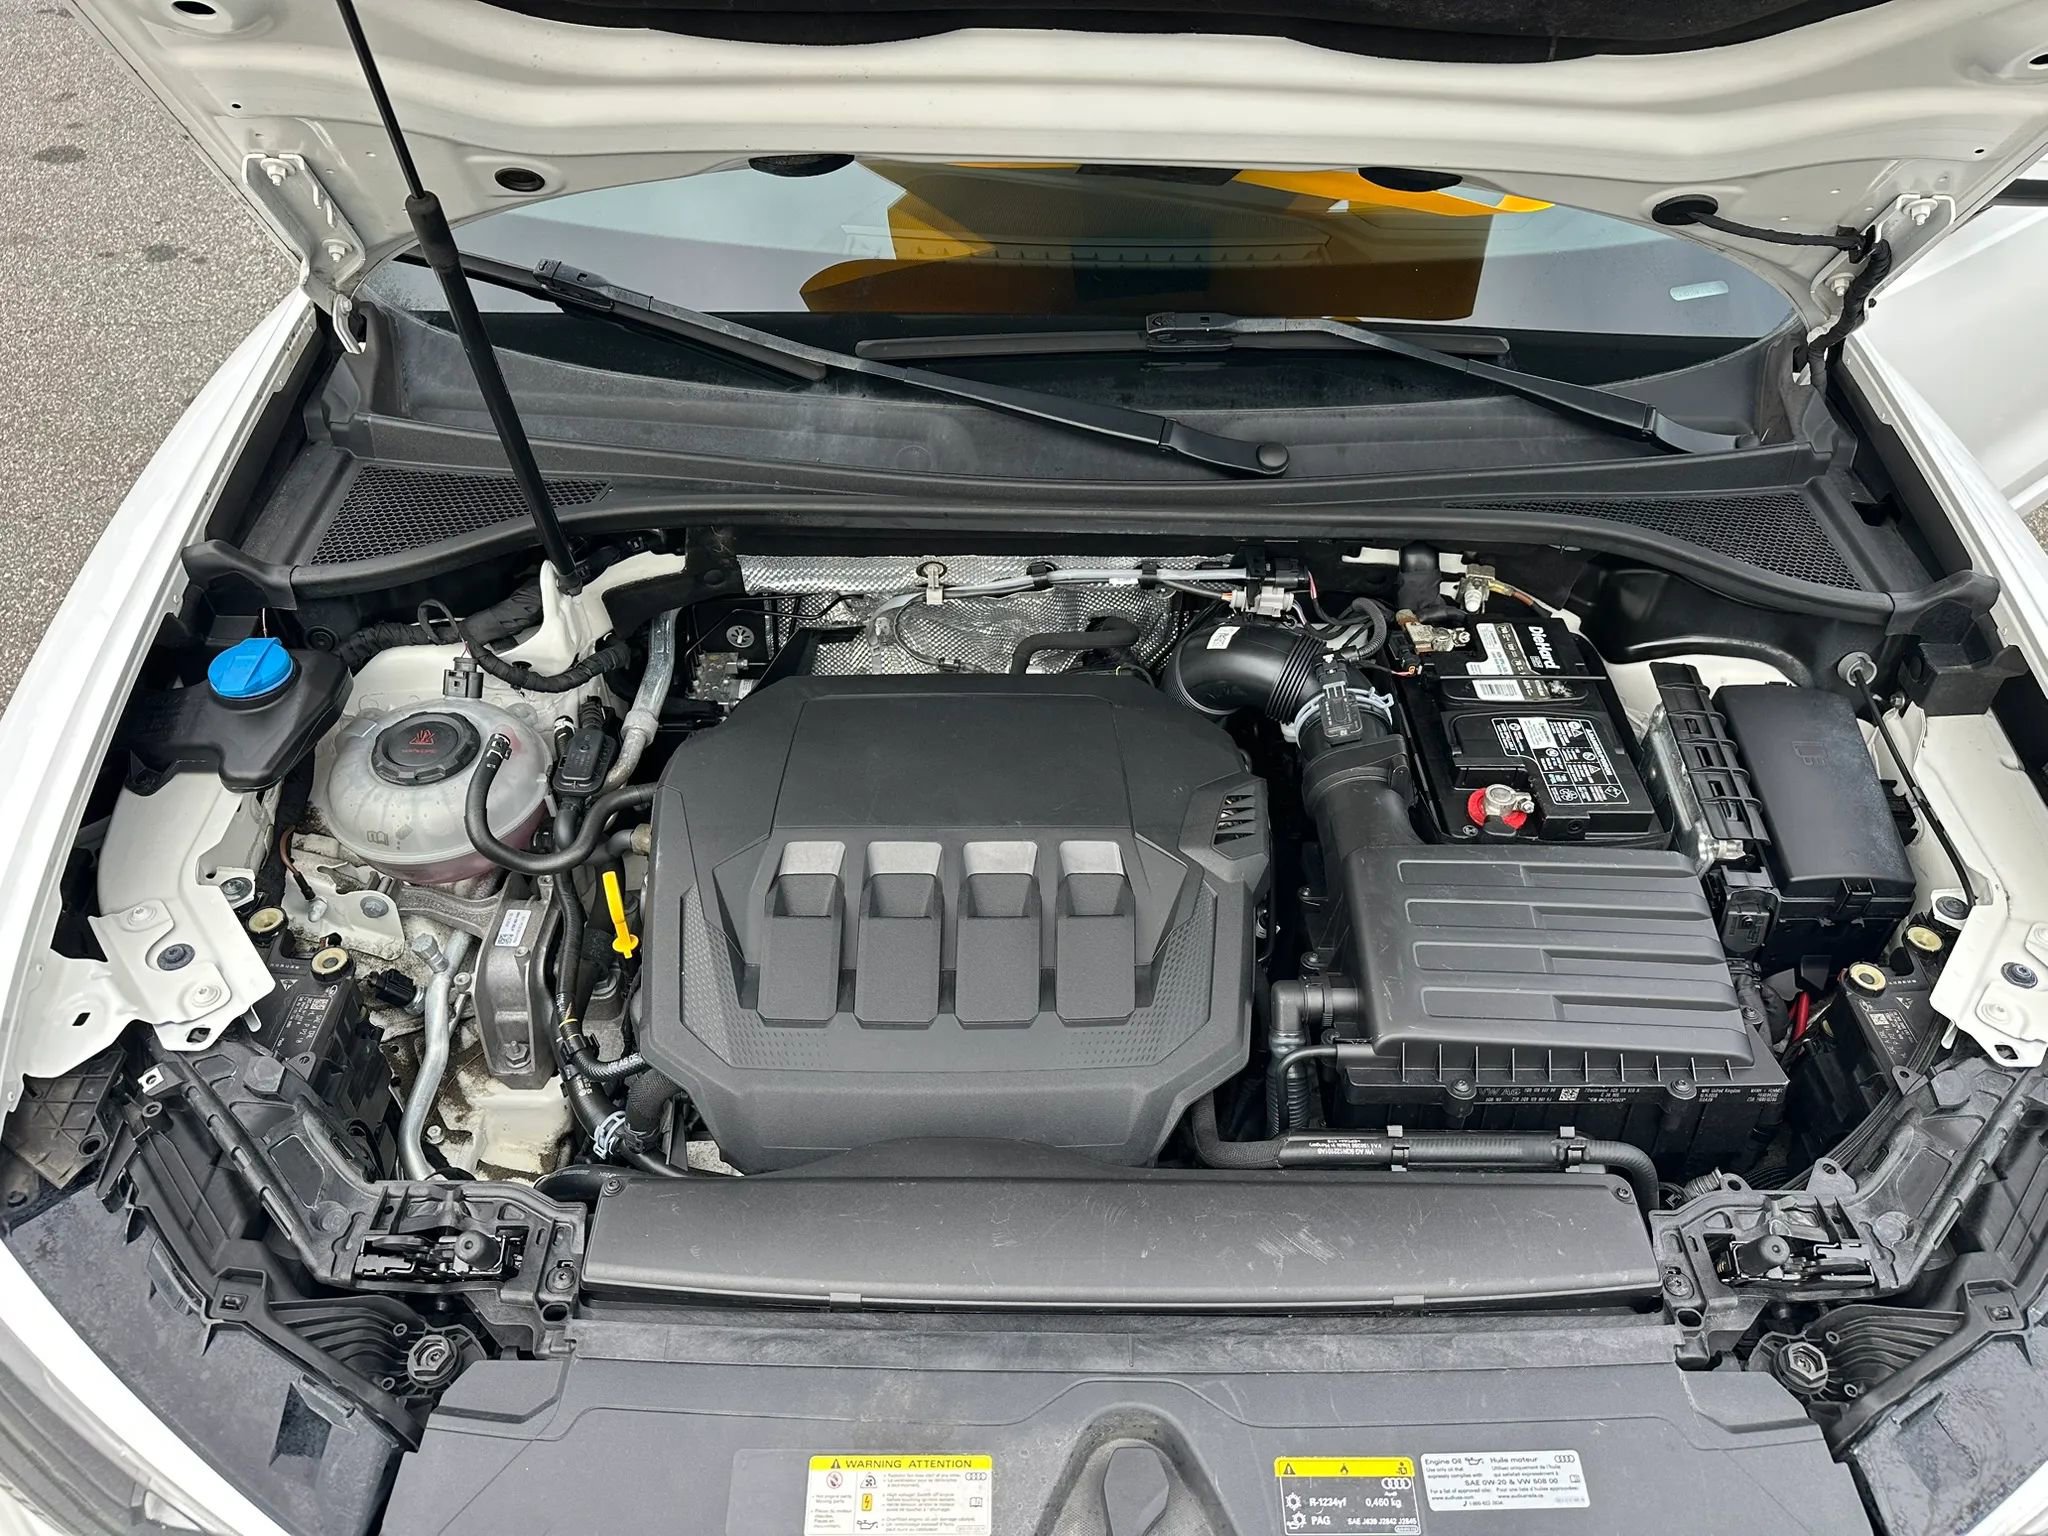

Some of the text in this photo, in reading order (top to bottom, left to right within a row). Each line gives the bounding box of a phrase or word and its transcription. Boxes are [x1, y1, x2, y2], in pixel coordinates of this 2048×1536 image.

[1528, 626, 1560, 669] DieHard
[845, 1459, 973, 1469] WARNING ATTENTION
[1425, 1458, 1450, 1466] Engine
[1309, 1497, 1347, 1508] R-1234yf
[1391, 1497, 1402, 1508] kg
[1311, 1516, 1331, 1525] PAG
